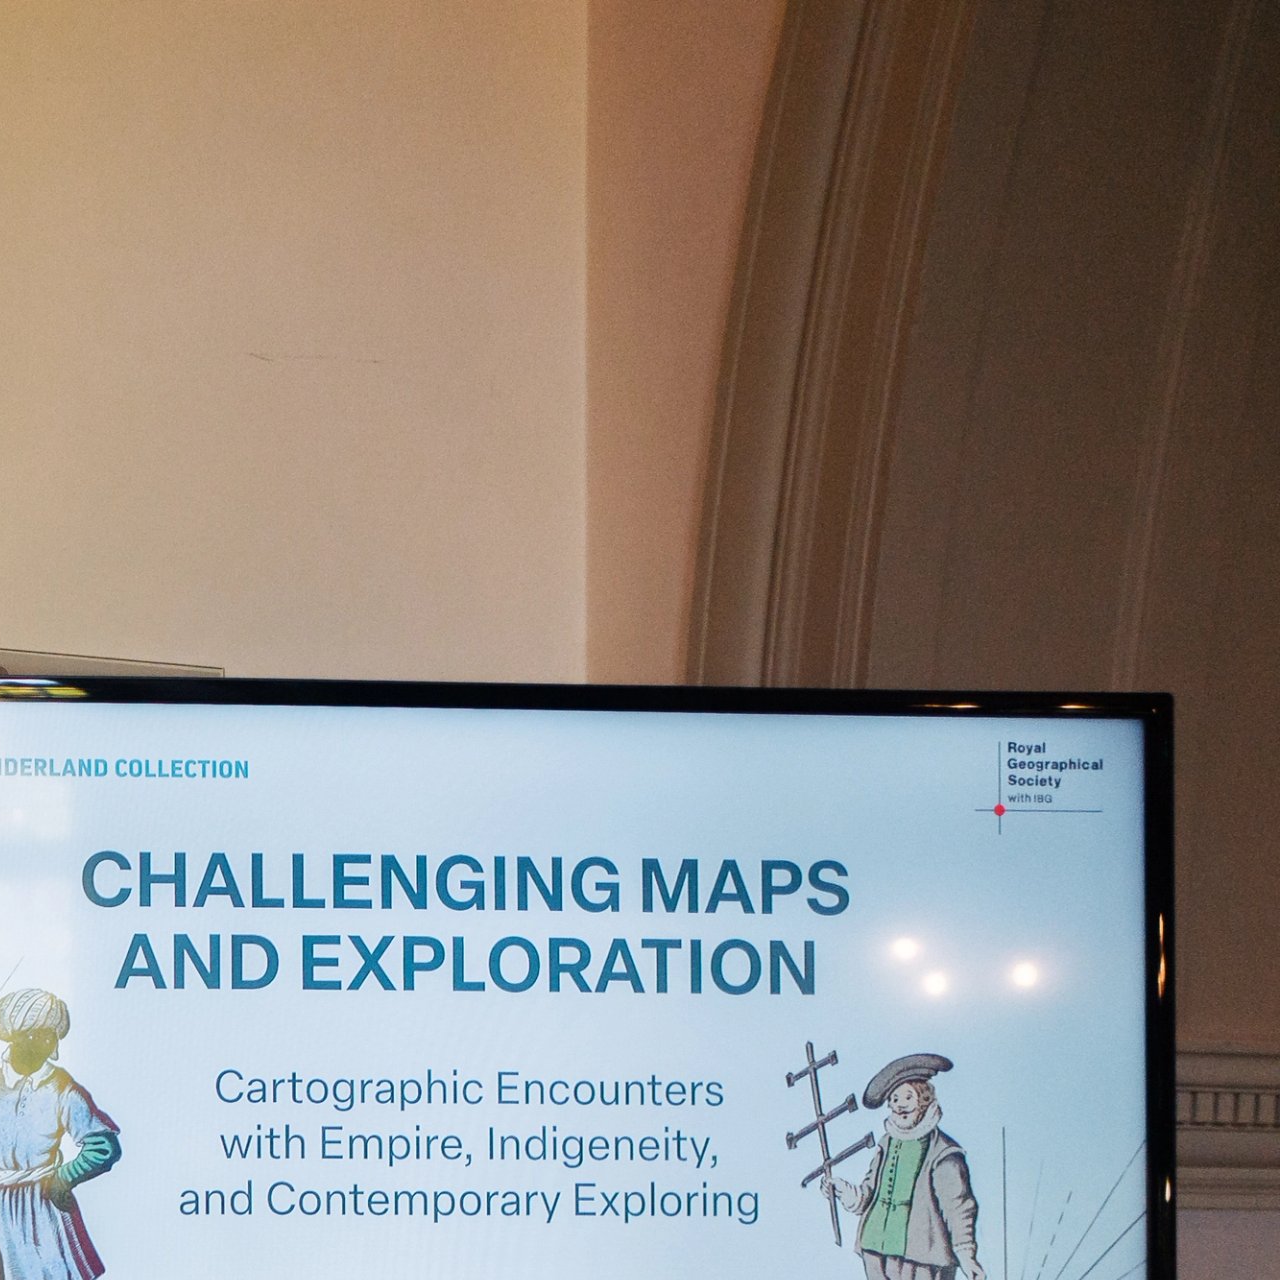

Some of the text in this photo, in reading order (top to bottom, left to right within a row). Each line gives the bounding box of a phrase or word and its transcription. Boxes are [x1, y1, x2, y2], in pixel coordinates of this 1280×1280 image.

[1007, 741, 1046, 755] Royal
[115, 758, 249, 779] COLLECTION
[1007, 758, 1104, 772] Geographical
[1008, 774, 1061, 789] Society
[1007, 793, 1053, 804] with IBG
[82, 851, 849, 916] CHALLENGING MAPS
[114, 933, 815, 995] AND EXPLORATION
[216, 1069, 724, 1112] Cartographic Encounters
[220, 1124, 717, 1169] with Empire, Indigeneity,
[180, 1180, 758, 1225] and Contemporary Exploring
